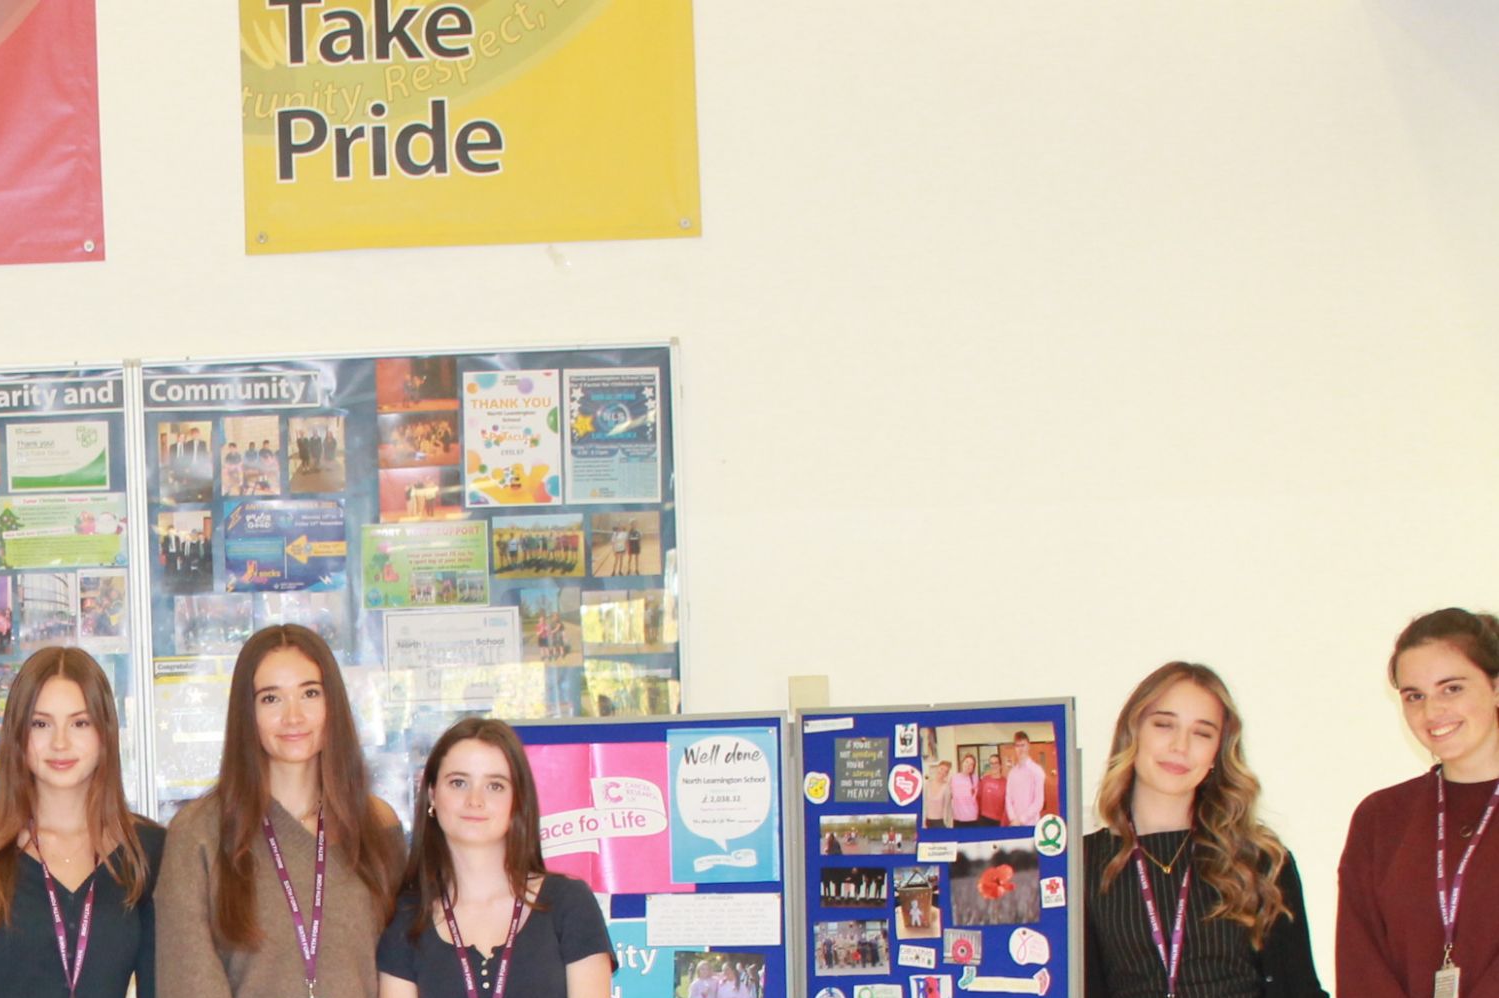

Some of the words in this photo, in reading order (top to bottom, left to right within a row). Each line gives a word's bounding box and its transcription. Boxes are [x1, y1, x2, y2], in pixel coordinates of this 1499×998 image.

[266, 0, 473, 67] Take
[275, 98, 504, 184] Pride
[64, 381, 114, 404] and
[149, 376, 306, 407] Community
[471, 398, 518, 409] THANK
[524, 397, 551, 408] YOU
[684, 744, 721, 766] Well
[725, 742, 762, 764] done
[847, 788, 875, 798] HEAVY
[538, 820, 574, 841] ace
[579, 814, 609, 834] fo
[611, 810, 647, 829] Life
